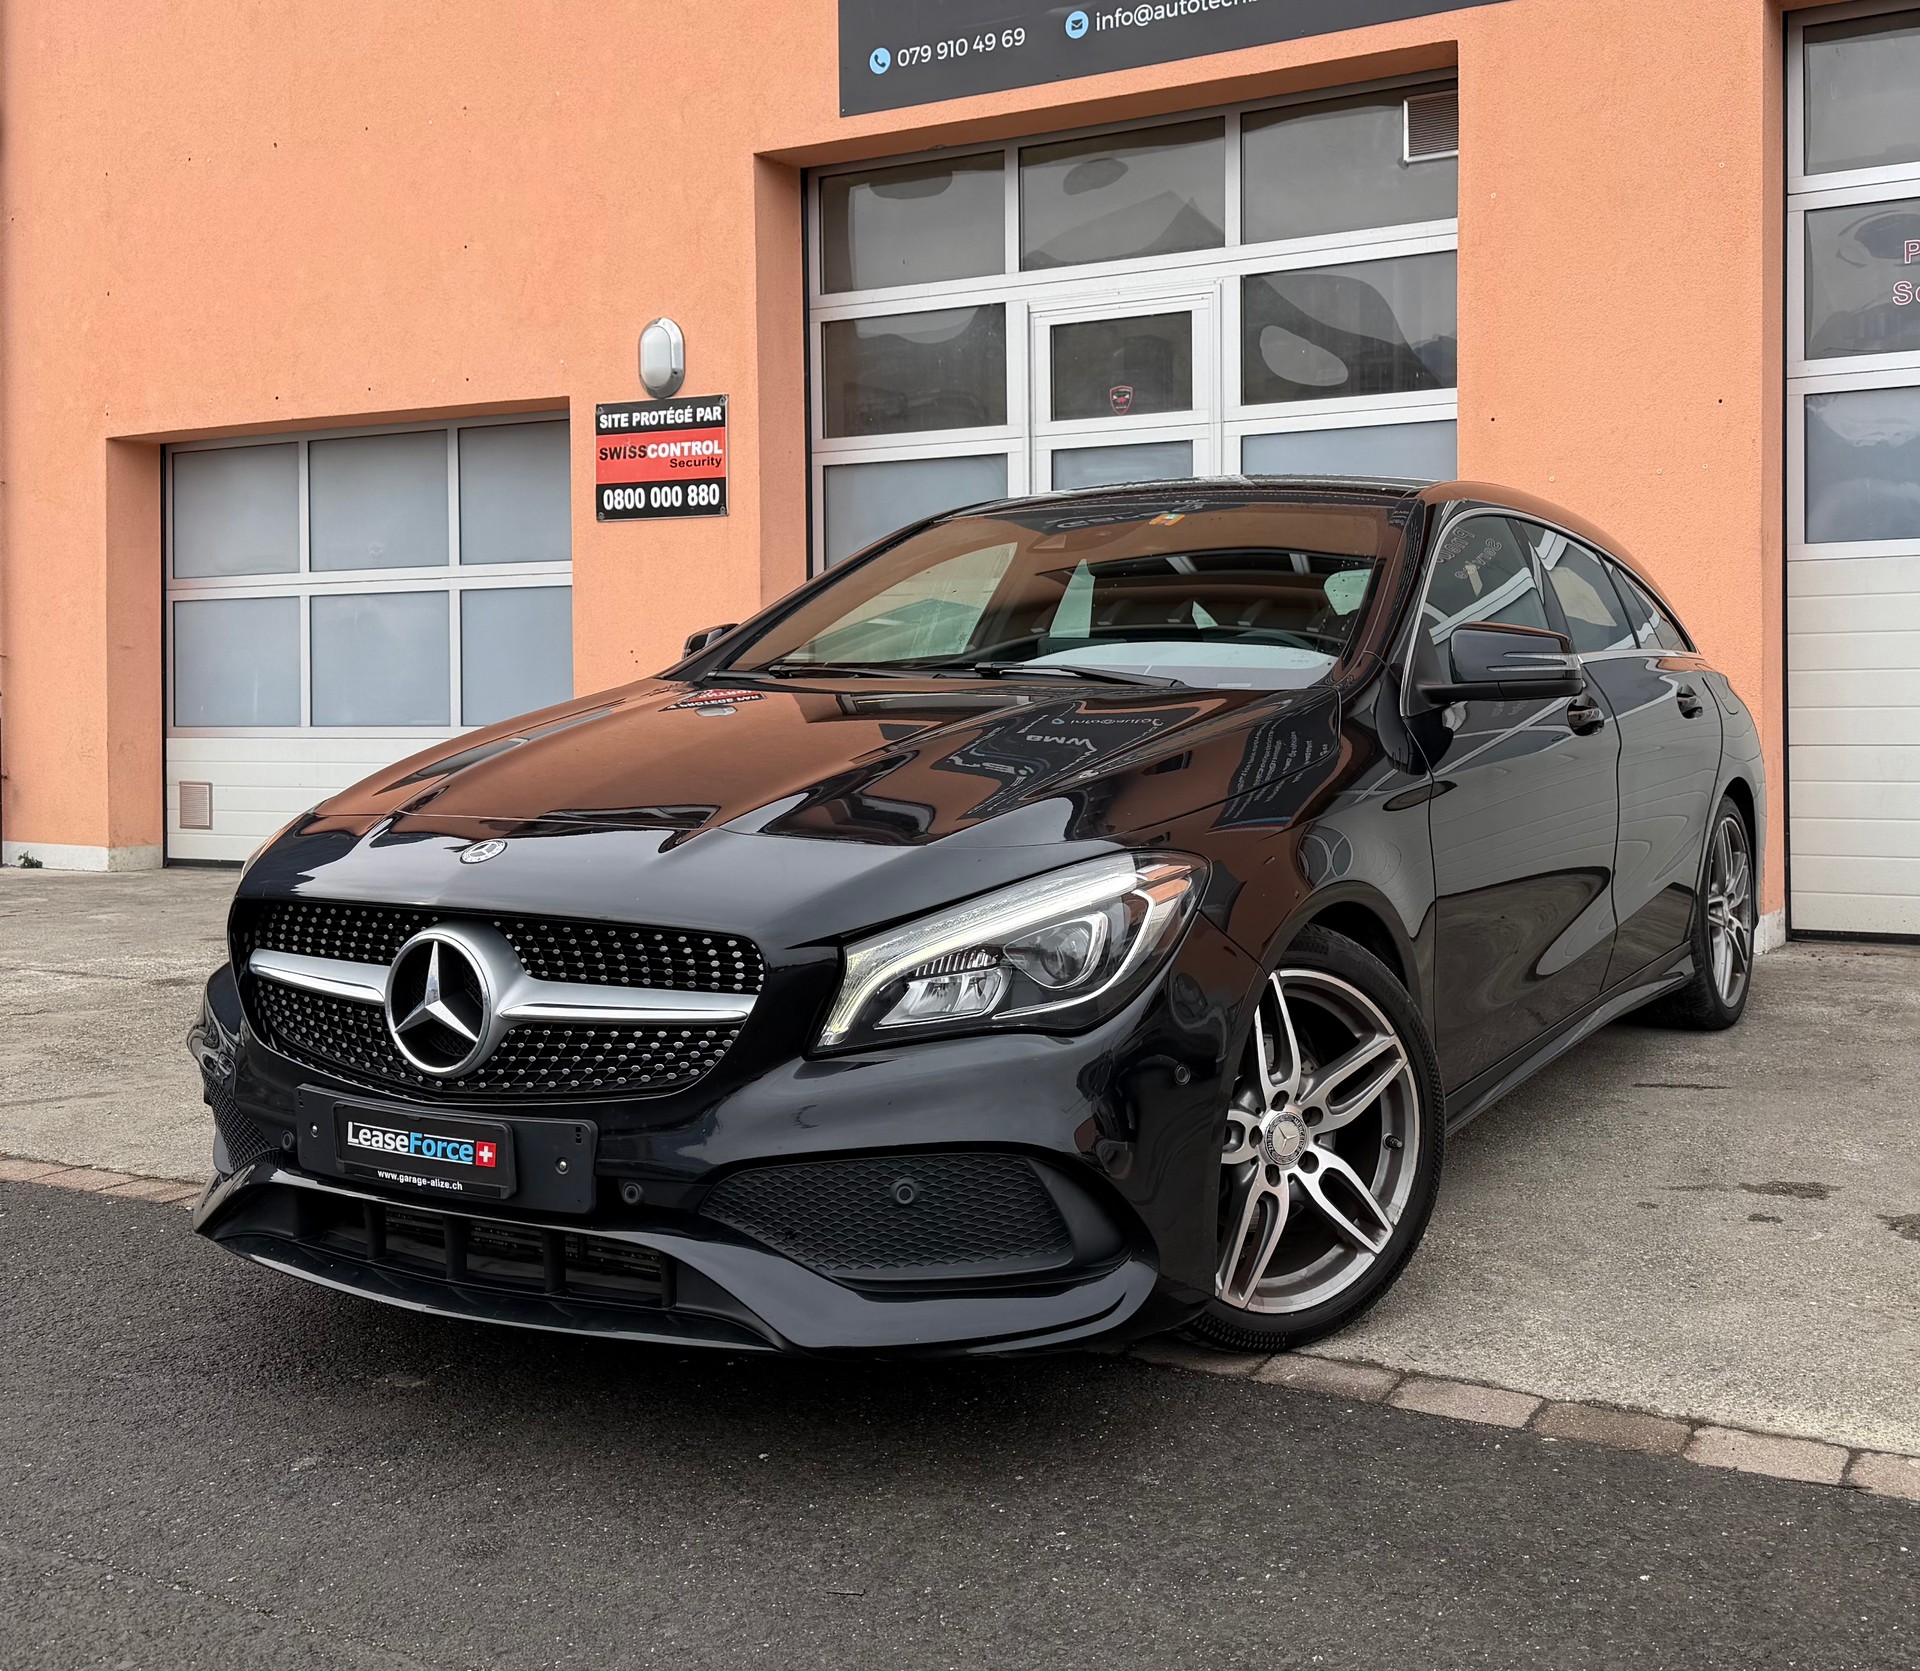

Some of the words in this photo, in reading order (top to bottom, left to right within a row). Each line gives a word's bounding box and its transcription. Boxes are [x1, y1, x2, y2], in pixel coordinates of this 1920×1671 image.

[897, 44, 932, 67] 079
[936, 38, 969, 60] 910
[972, 32, 997, 53] 49
[1001, 27, 1026, 48] 69
[599, 412, 629, 429] SITE
[632, 405, 693, 427] PROTÉGÉ
[696, 406, 722, 422] PAR
[599, 439, 723, 461] SWISSCONTROL
[669, 456, 722, 468] Security
[603, 487, 646, 511] 0800
[650, 485, 683, 509] 000
[687, 483, 720, 507] 880
[347, 1120, 475, 1162] LeaseForce
[377, 1169, 463, 1191] www.garage-alize.ch
